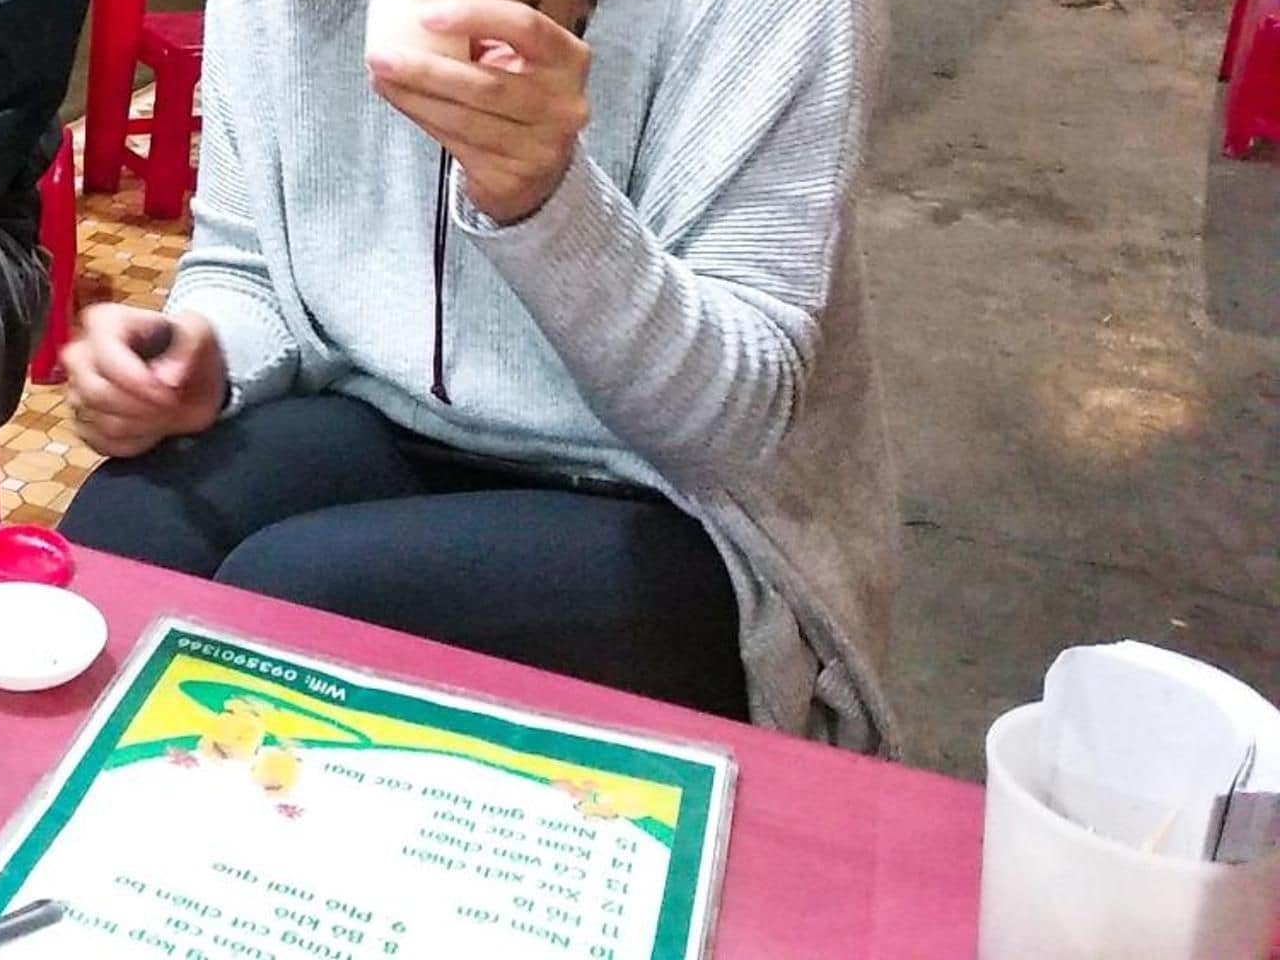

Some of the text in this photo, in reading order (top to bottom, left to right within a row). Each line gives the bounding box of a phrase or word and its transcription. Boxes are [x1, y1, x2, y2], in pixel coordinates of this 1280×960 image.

[177, 637, 345, 699] Wifi: 0935901366
[265, 879, 314, 902] mai
[510, 919, 570, 948] Nem
